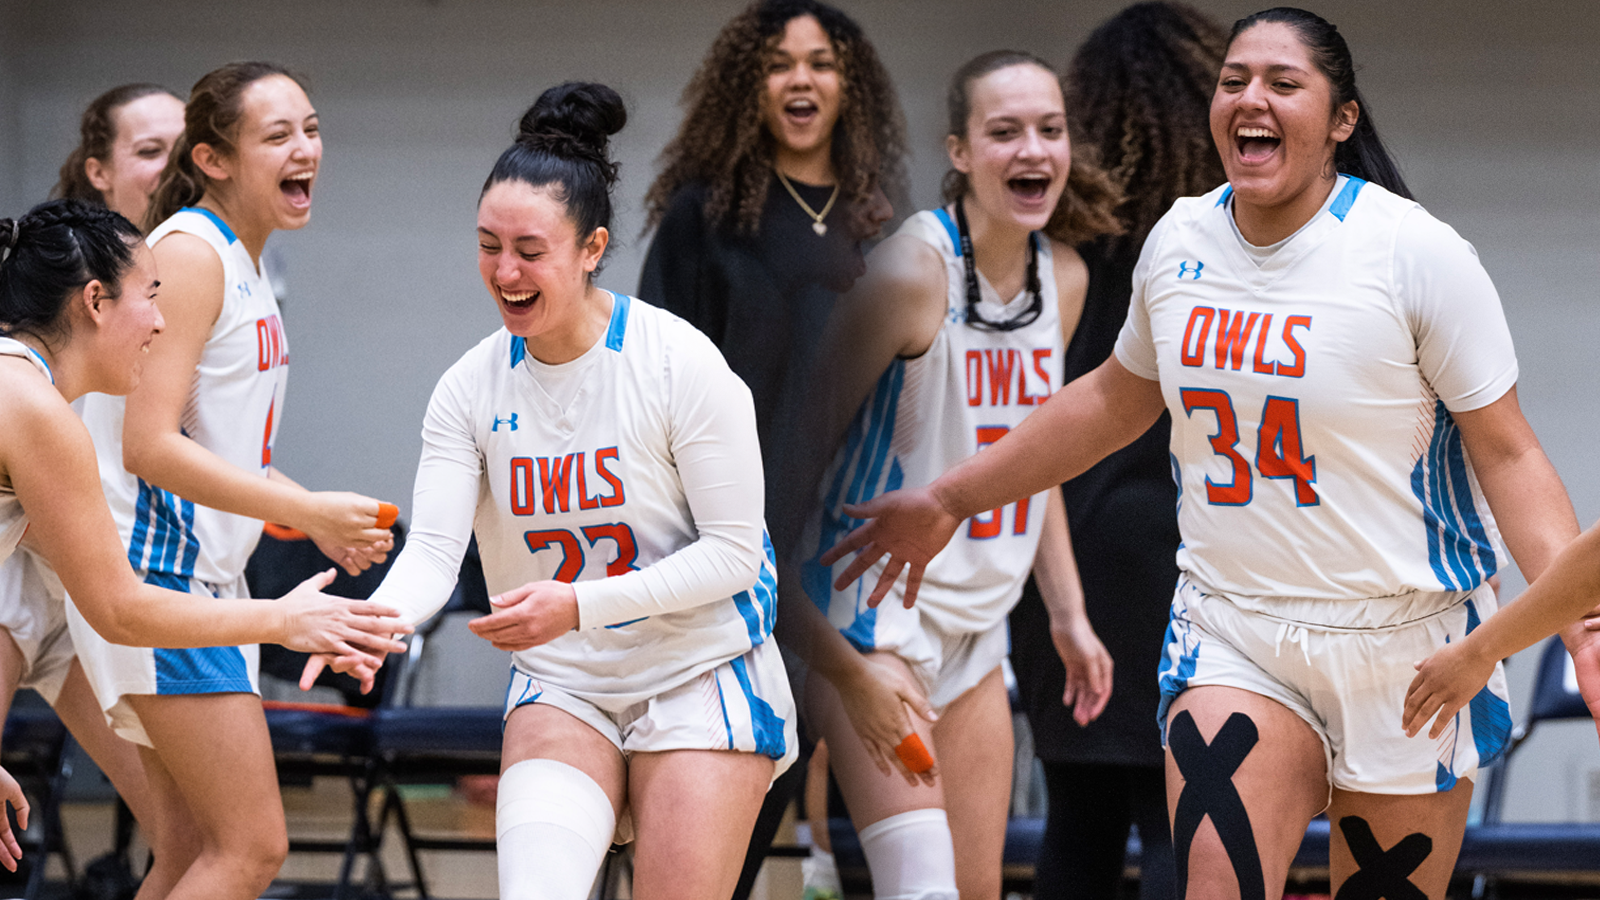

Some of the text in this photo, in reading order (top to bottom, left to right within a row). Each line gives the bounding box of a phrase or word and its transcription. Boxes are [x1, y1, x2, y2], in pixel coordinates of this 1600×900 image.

[256, 314, 289, 372] OWL
[1181, 305, 1312, 378] OWLS
[965, 348, 1052, 406] OWLS
[510, 446, 625, 516] OWLS
[1179, 387, 1320, 508] 34
